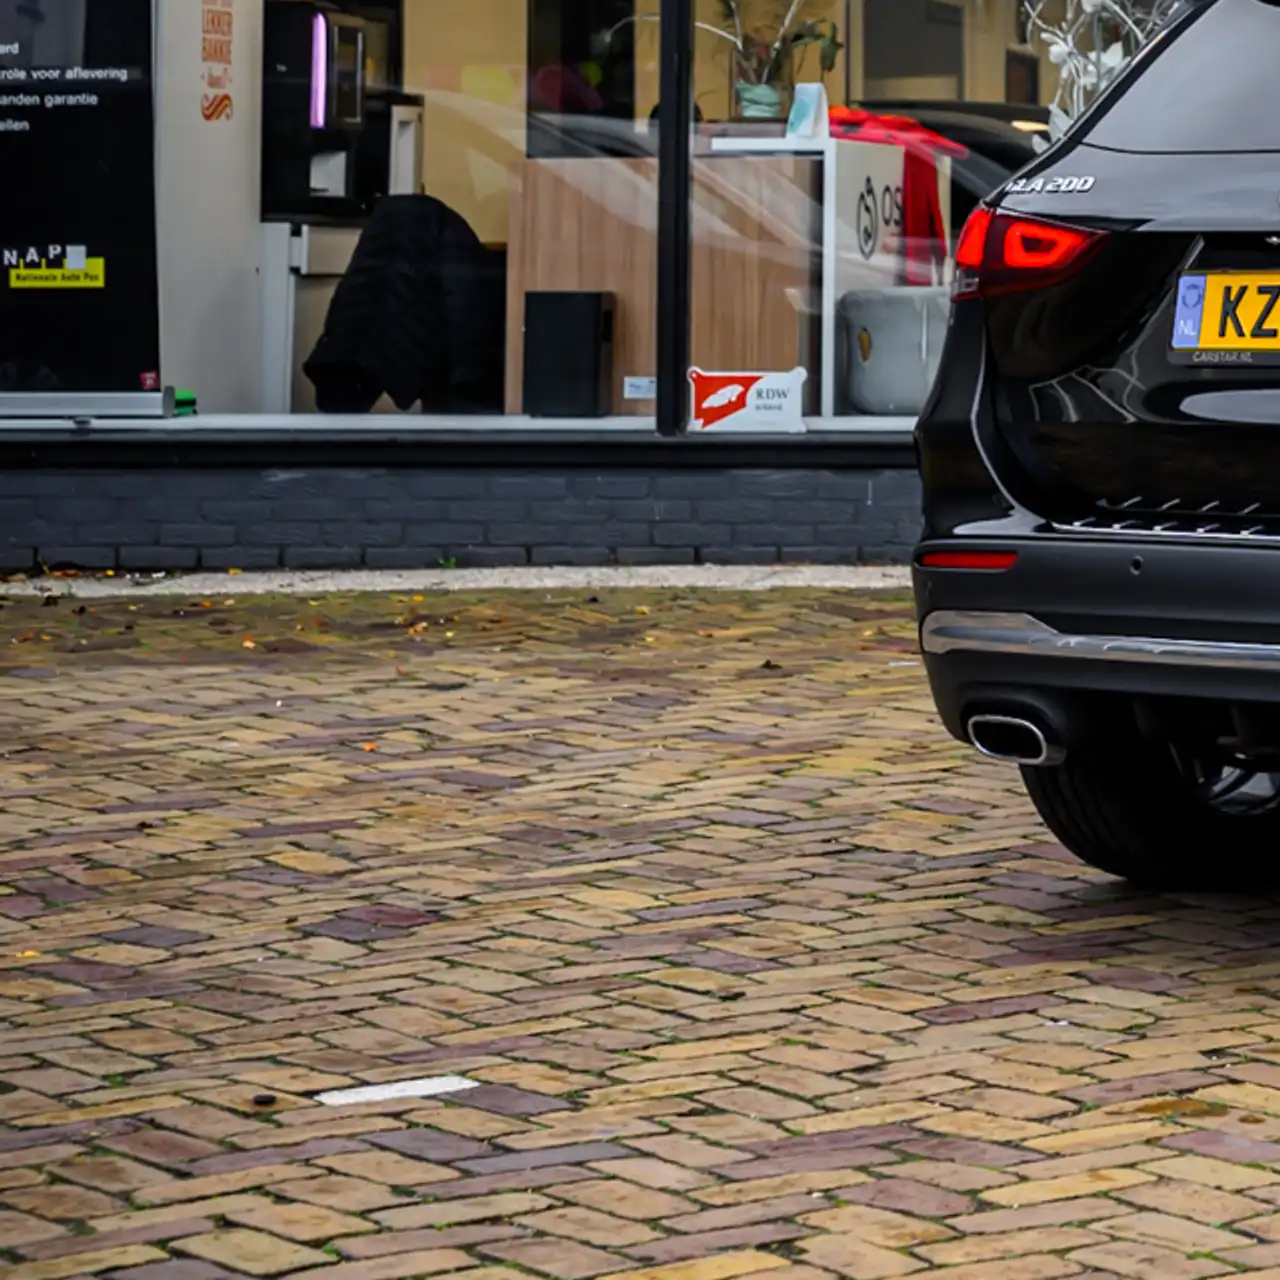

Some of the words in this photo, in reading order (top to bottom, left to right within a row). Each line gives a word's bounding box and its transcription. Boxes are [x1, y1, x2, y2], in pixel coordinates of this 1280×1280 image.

[30, 69, 61, 80] voor
[65, 66, 128, 82] aflevering
[44, 93, 99, 108] garantie
[1045, 176, 1096, 192] 200
[1178, 319, 1197, 336] NL
[756, 387, 790, 400] RDW
